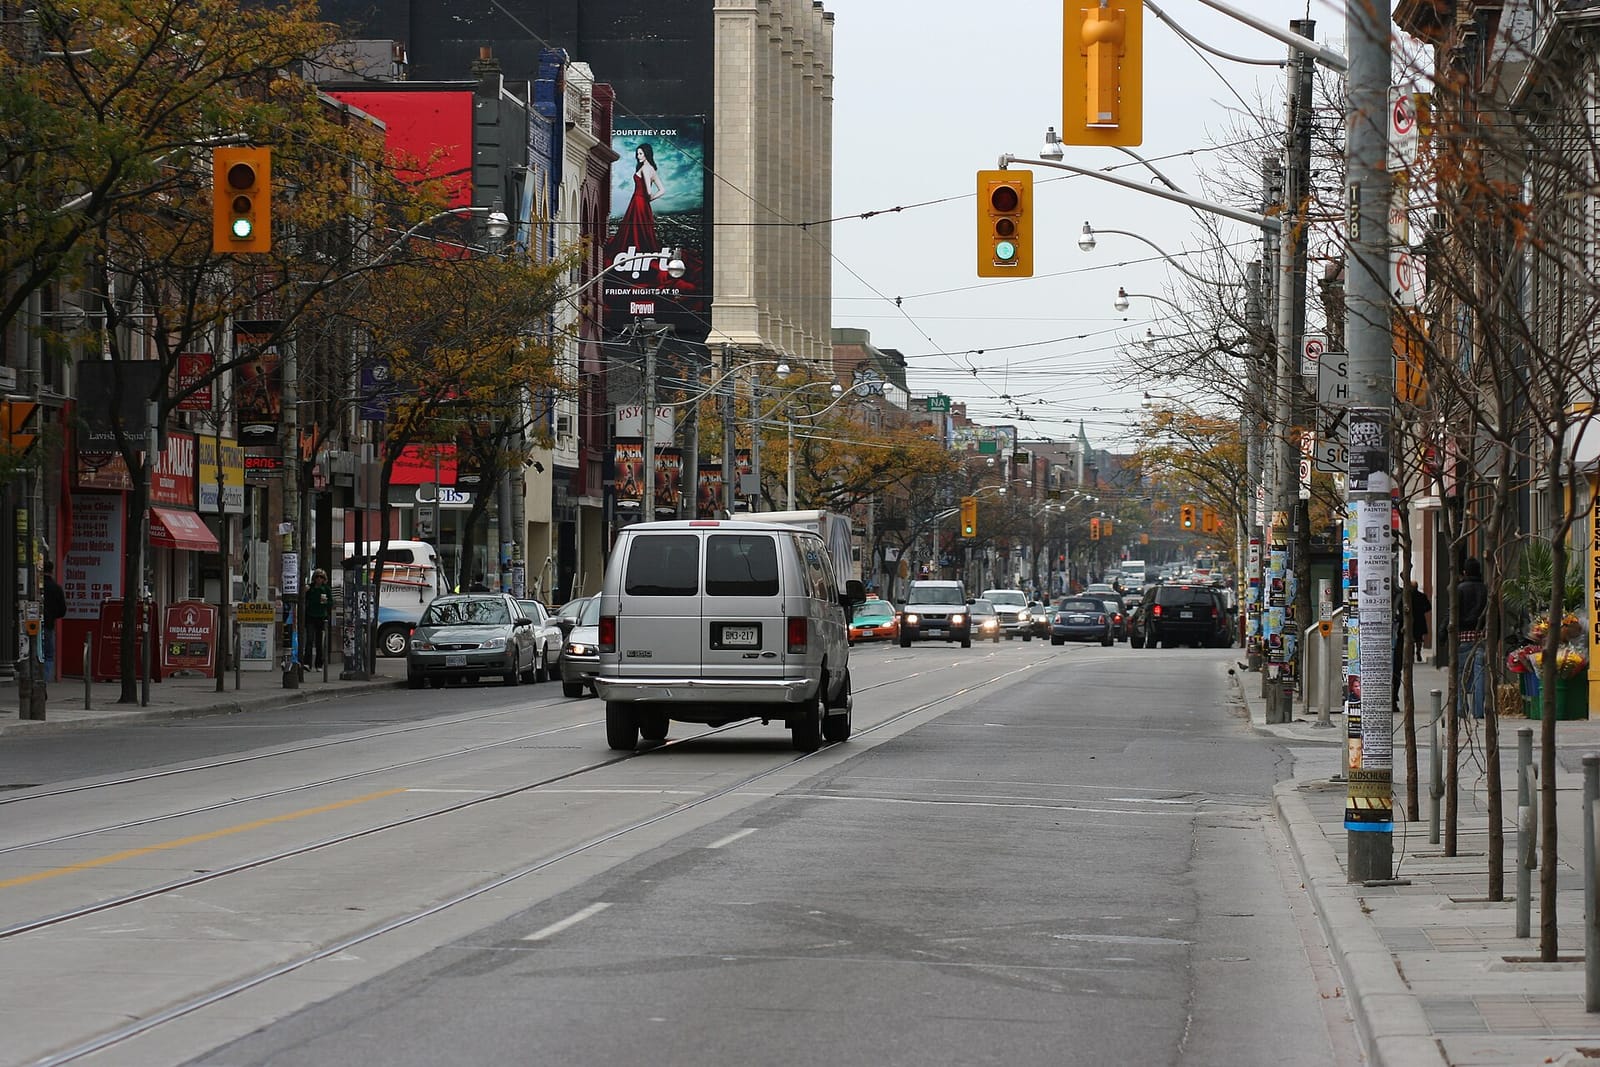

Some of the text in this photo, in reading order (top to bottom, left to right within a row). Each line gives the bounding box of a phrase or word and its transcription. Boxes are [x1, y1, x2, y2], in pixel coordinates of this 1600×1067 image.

[613, 246, 671, 279] dirt
[630, 302, 655, 314] Bravo!
[619, 405, 672, 421] PSYIC
[168, 437, 194, 478] PALACE
[237, 603, 273, 611] GLOBAL
